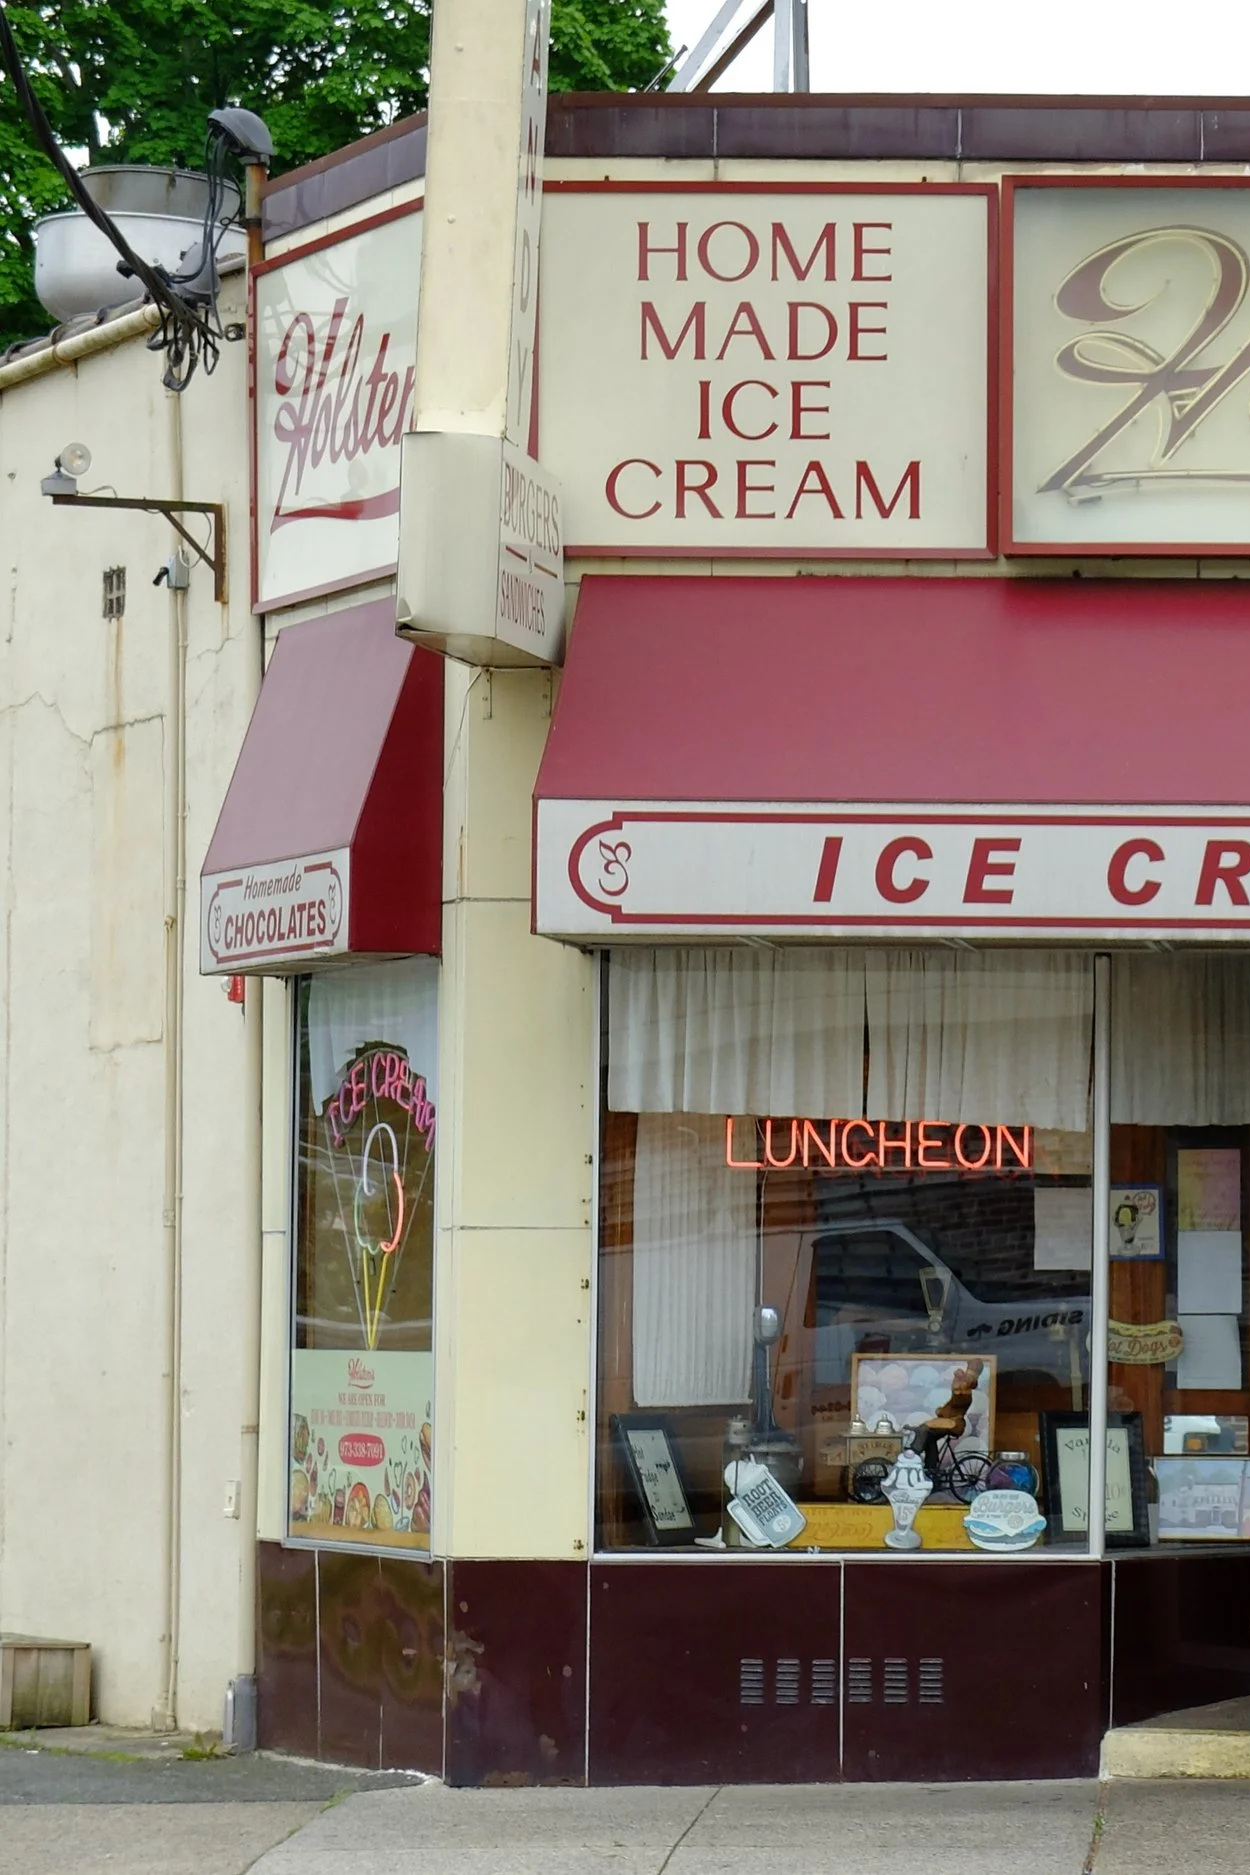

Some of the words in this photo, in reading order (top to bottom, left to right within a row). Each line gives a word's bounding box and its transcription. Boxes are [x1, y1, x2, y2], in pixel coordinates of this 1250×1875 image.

[636, 221, 894, 283] HOME
[640, 301, 889, 361] MADE
[697, 379, 831, 441] ICE
[503, 461, 561, 557] BURGERS
[605, 458, 922, 520] CREAM
[500, 569, 546, 637] SANDWICHES
[243, 863, 302, 901] Homemade
[813, 836, 1022, 905] ICE
[224, 898, 327, 951] CHOCOLATES
[328, 1062, 367, 1147] ICE
[371, 1052, 436, 1152] CREAM
[725, 1117, 1032, 1169] LUNCHEON
[1124, 1336, 1168, 1357] Dogs
[742, 1478, 773, 1508] ROOT
[751, 1491, 781, 1518] BEER
[759, 1500, 788, 1527] FLOATS
[973, 1495, 1035, 1513] Burgers
